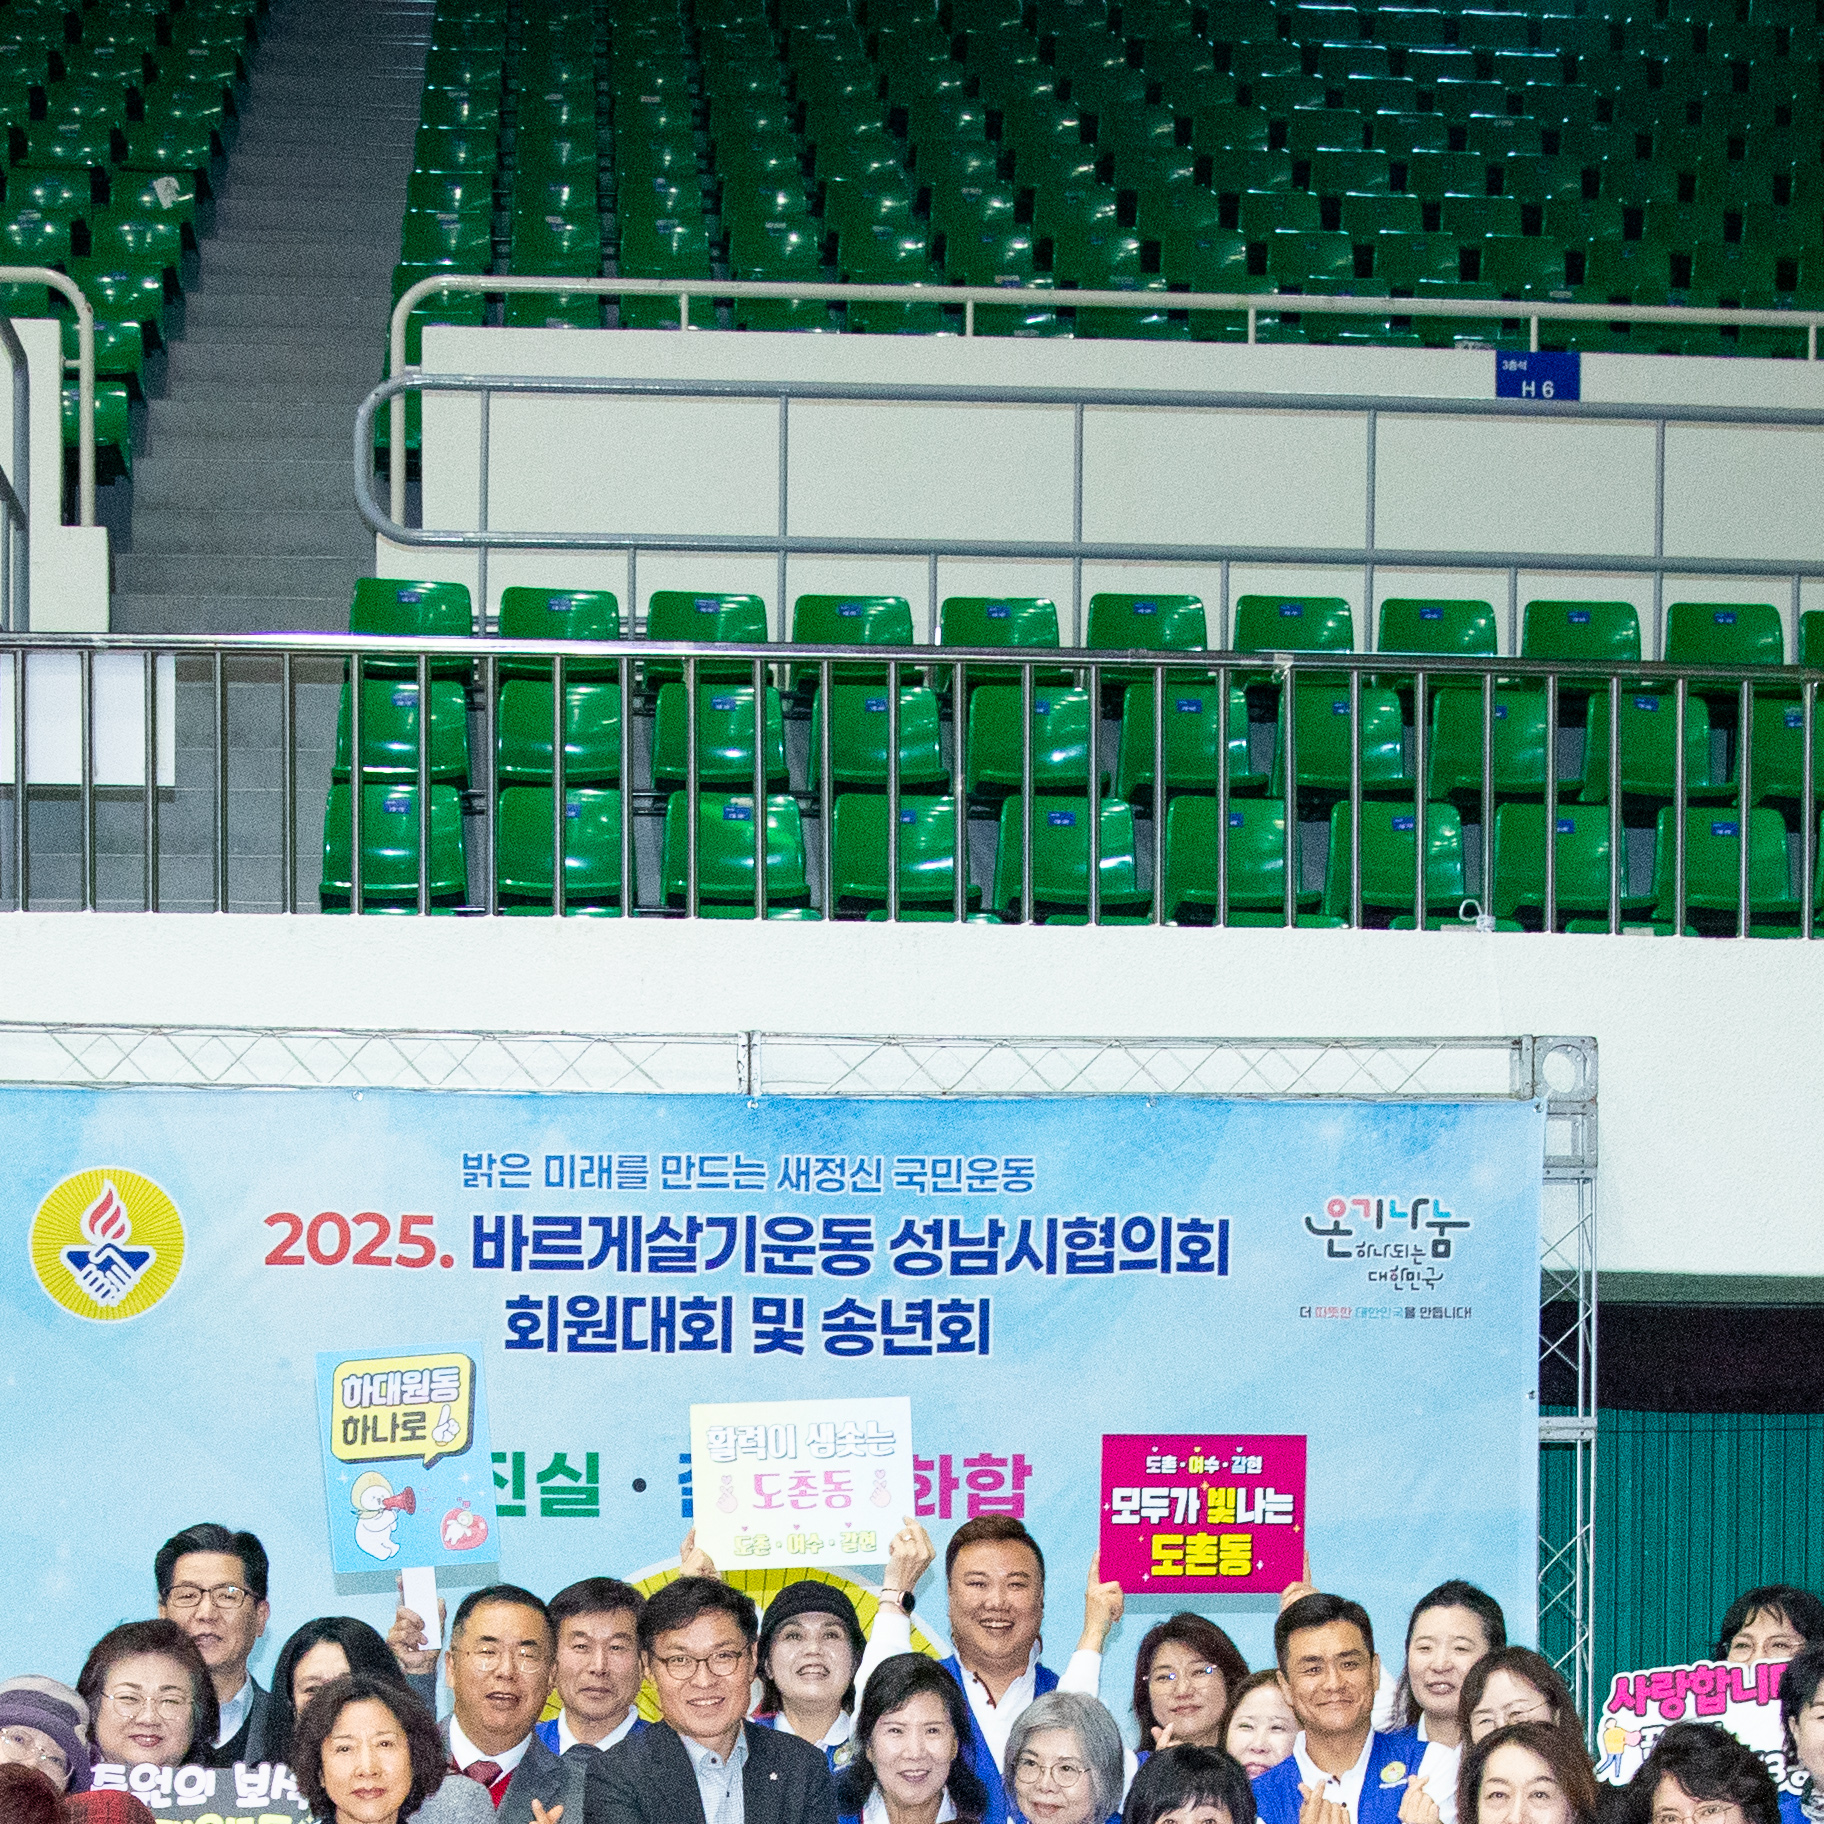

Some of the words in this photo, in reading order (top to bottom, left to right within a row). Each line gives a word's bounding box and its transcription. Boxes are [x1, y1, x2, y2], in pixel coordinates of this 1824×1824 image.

[1542, 380, 1554, 398] 6
[462, 1153, 531, 1190] 밝은
[544, 1154, 649, 1190] 미래를
[661, 1155, 766, 1191] 만드는
[777, 1156, 882, 1194] 새정신
[892, 1157, 1035, 1194] 국민운동
[263, 1211, 454, 1269] 2025.
[472, 1215, 875, 1276] 바르게살기운동
[889, 1217, 1229, 1277] 성남시협의회
[1305, 1198, 1470, 1258] 온기나눔
[1356, 1241, 1426, 1265] 하나되는
[1368, 1265, 1444, 1290] 대한민국
[504, 1294, 733, 1354] 회원대회
[752, 1297, 804, 1355] 및
[820, 1297, 989, 1356] 송년회
[1300, 1306, 1311, 1318] 더
[1315, 1306, 1352, 1319] 따뜻한
[341, 1366, 461, 1409] 하대원동
[341, 1411, 427, 1446] 하나로
[706, 1423, 798, 1464] 활력이
[491, 1451, 600, 1517] 진실
[914, 1452, 1033, 1520] 화합
[752, 1469, 854, 1510] 도촌동
[1111, 1487, 1201, 1525] 모두가
[1207, 1487, 1294, 1525] 빛나는
[1150, 1531, 1252, 1577] 도촌동
[1607, 1662, 1788, 1720] 사랑합니
